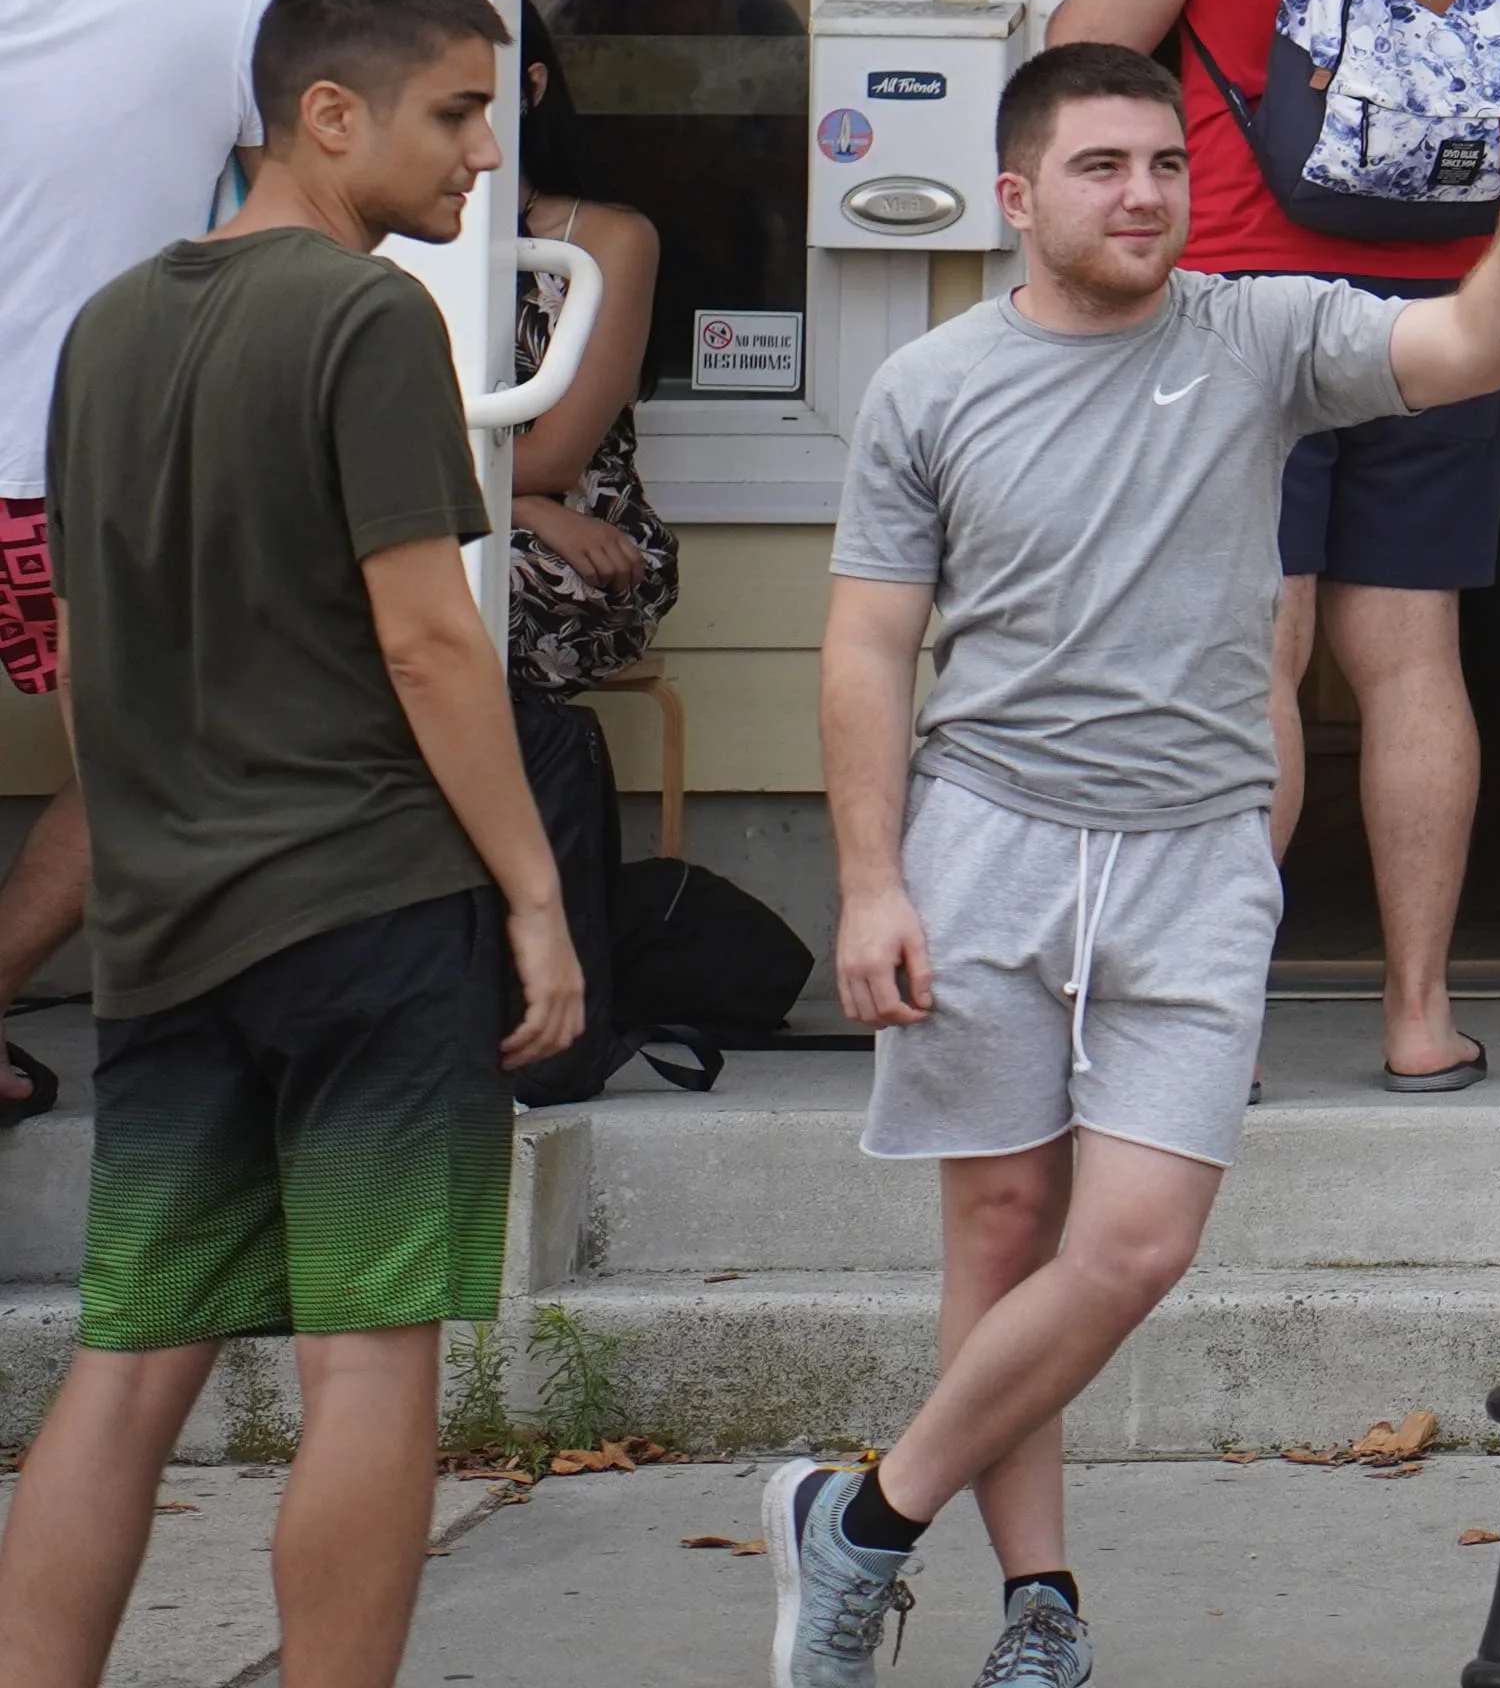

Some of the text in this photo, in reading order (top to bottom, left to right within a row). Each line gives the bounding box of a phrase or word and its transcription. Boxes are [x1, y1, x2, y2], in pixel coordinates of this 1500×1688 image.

[872, 77, 942, 95] All Friends
[735, 334, 792, 349] NO PUBLIC
[703, 352, 792, 371] RESTROOMS
